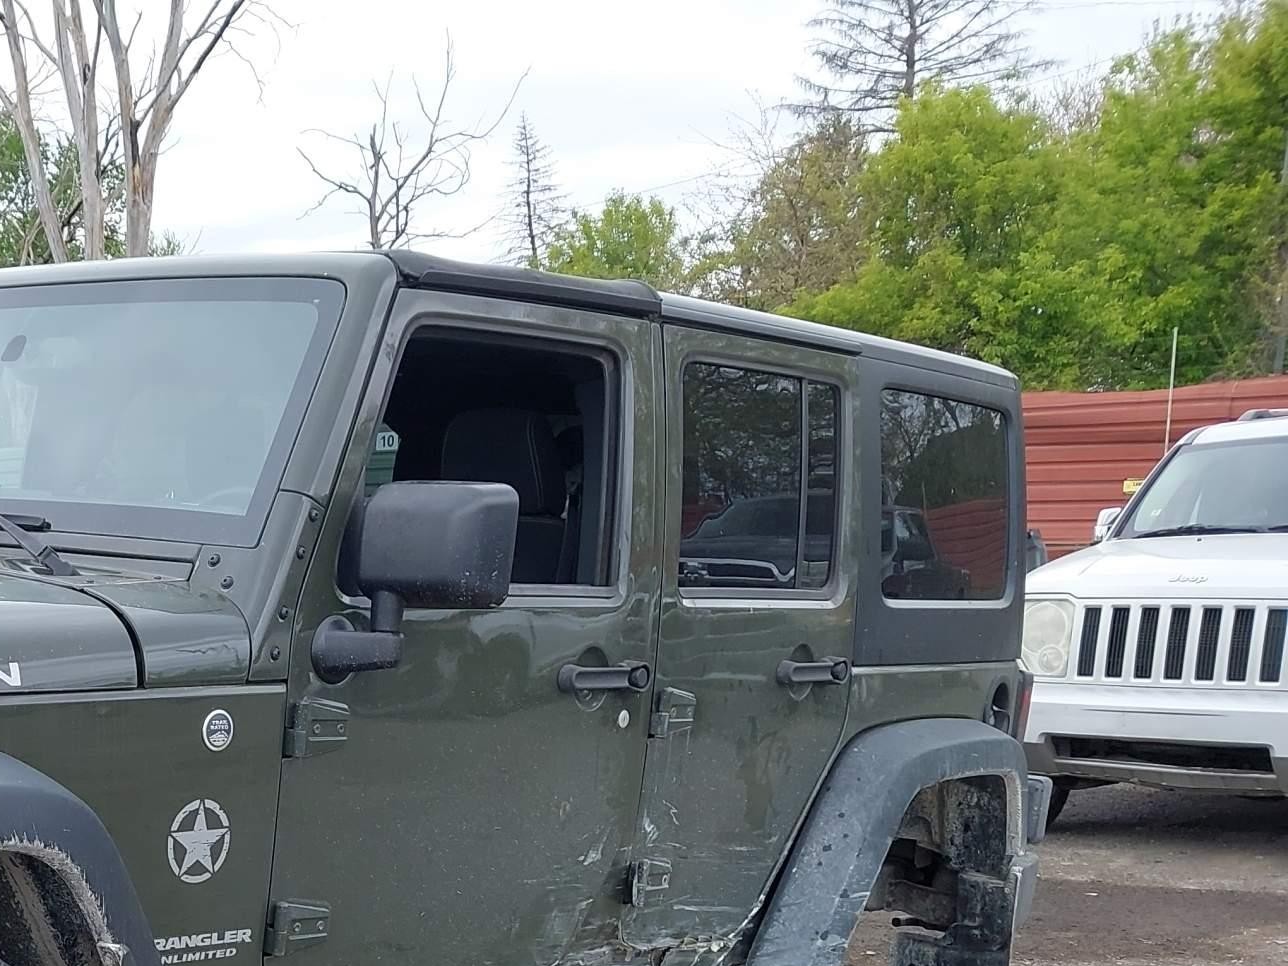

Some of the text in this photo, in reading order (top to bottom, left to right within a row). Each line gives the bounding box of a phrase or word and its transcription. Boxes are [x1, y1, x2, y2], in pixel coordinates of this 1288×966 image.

[380, 434, 394, 448] 10
[153, 928, 253, 951] RANGLER
[160, 947, 238, 966] NLIMITED
